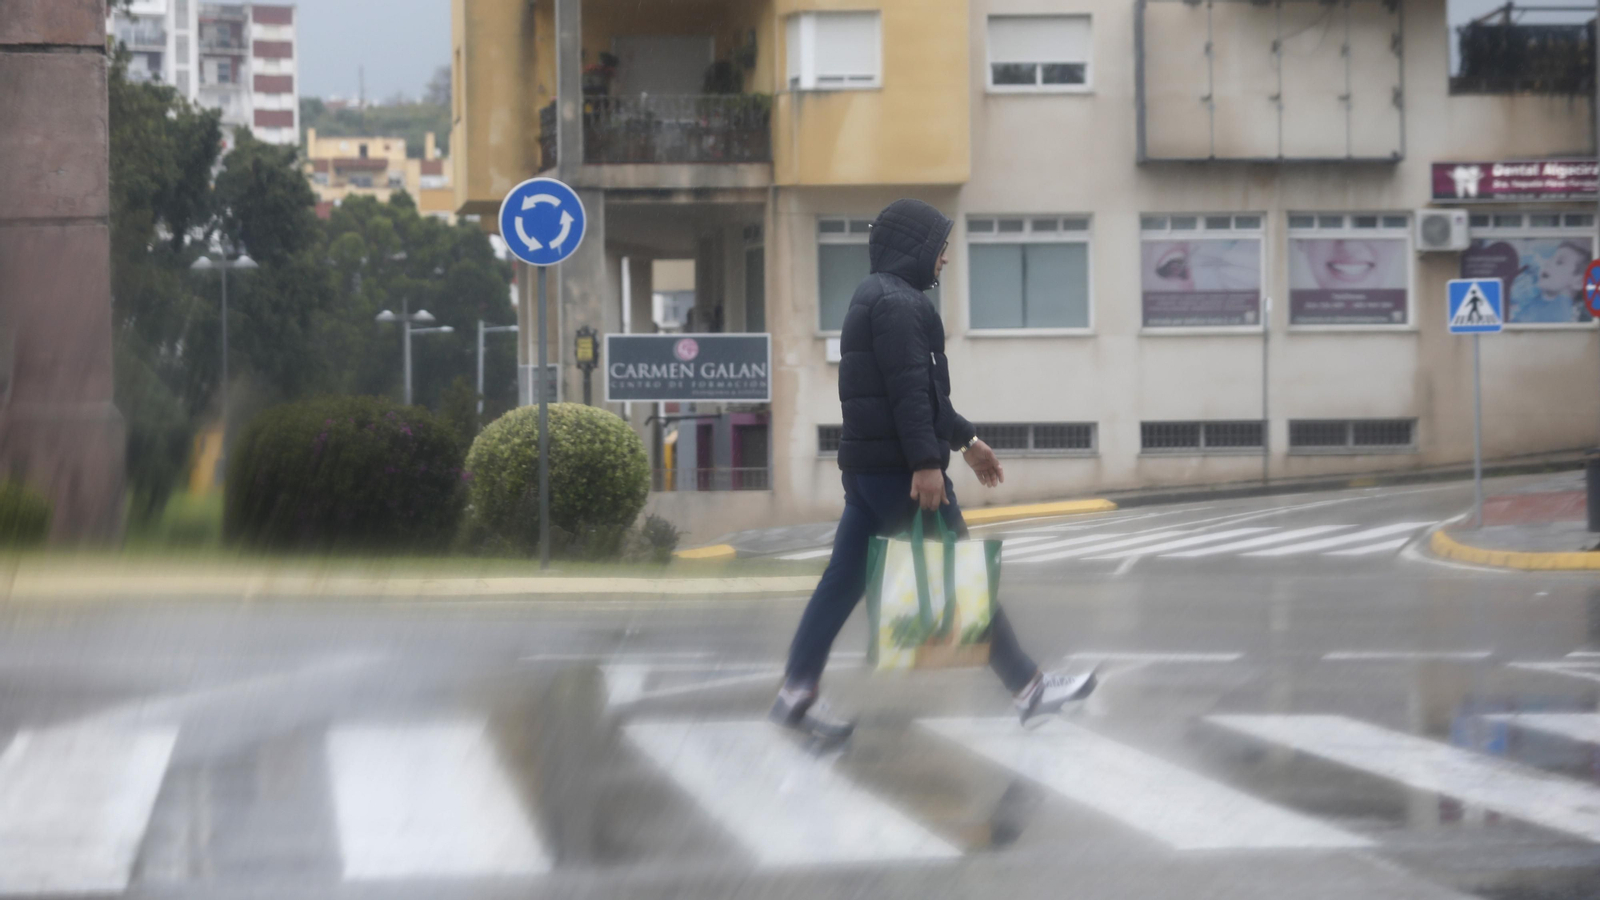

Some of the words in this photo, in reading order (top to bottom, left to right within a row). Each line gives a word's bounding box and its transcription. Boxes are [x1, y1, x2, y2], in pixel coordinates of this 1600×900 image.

[1492, 164, 1539, 177] Dental
[610, 362, 694, 379] CARMEN
[700, 362, 766, 379] GALAN
[610, 380, 661, 388] CENTRO
[670, 380, 683, 388] DE
